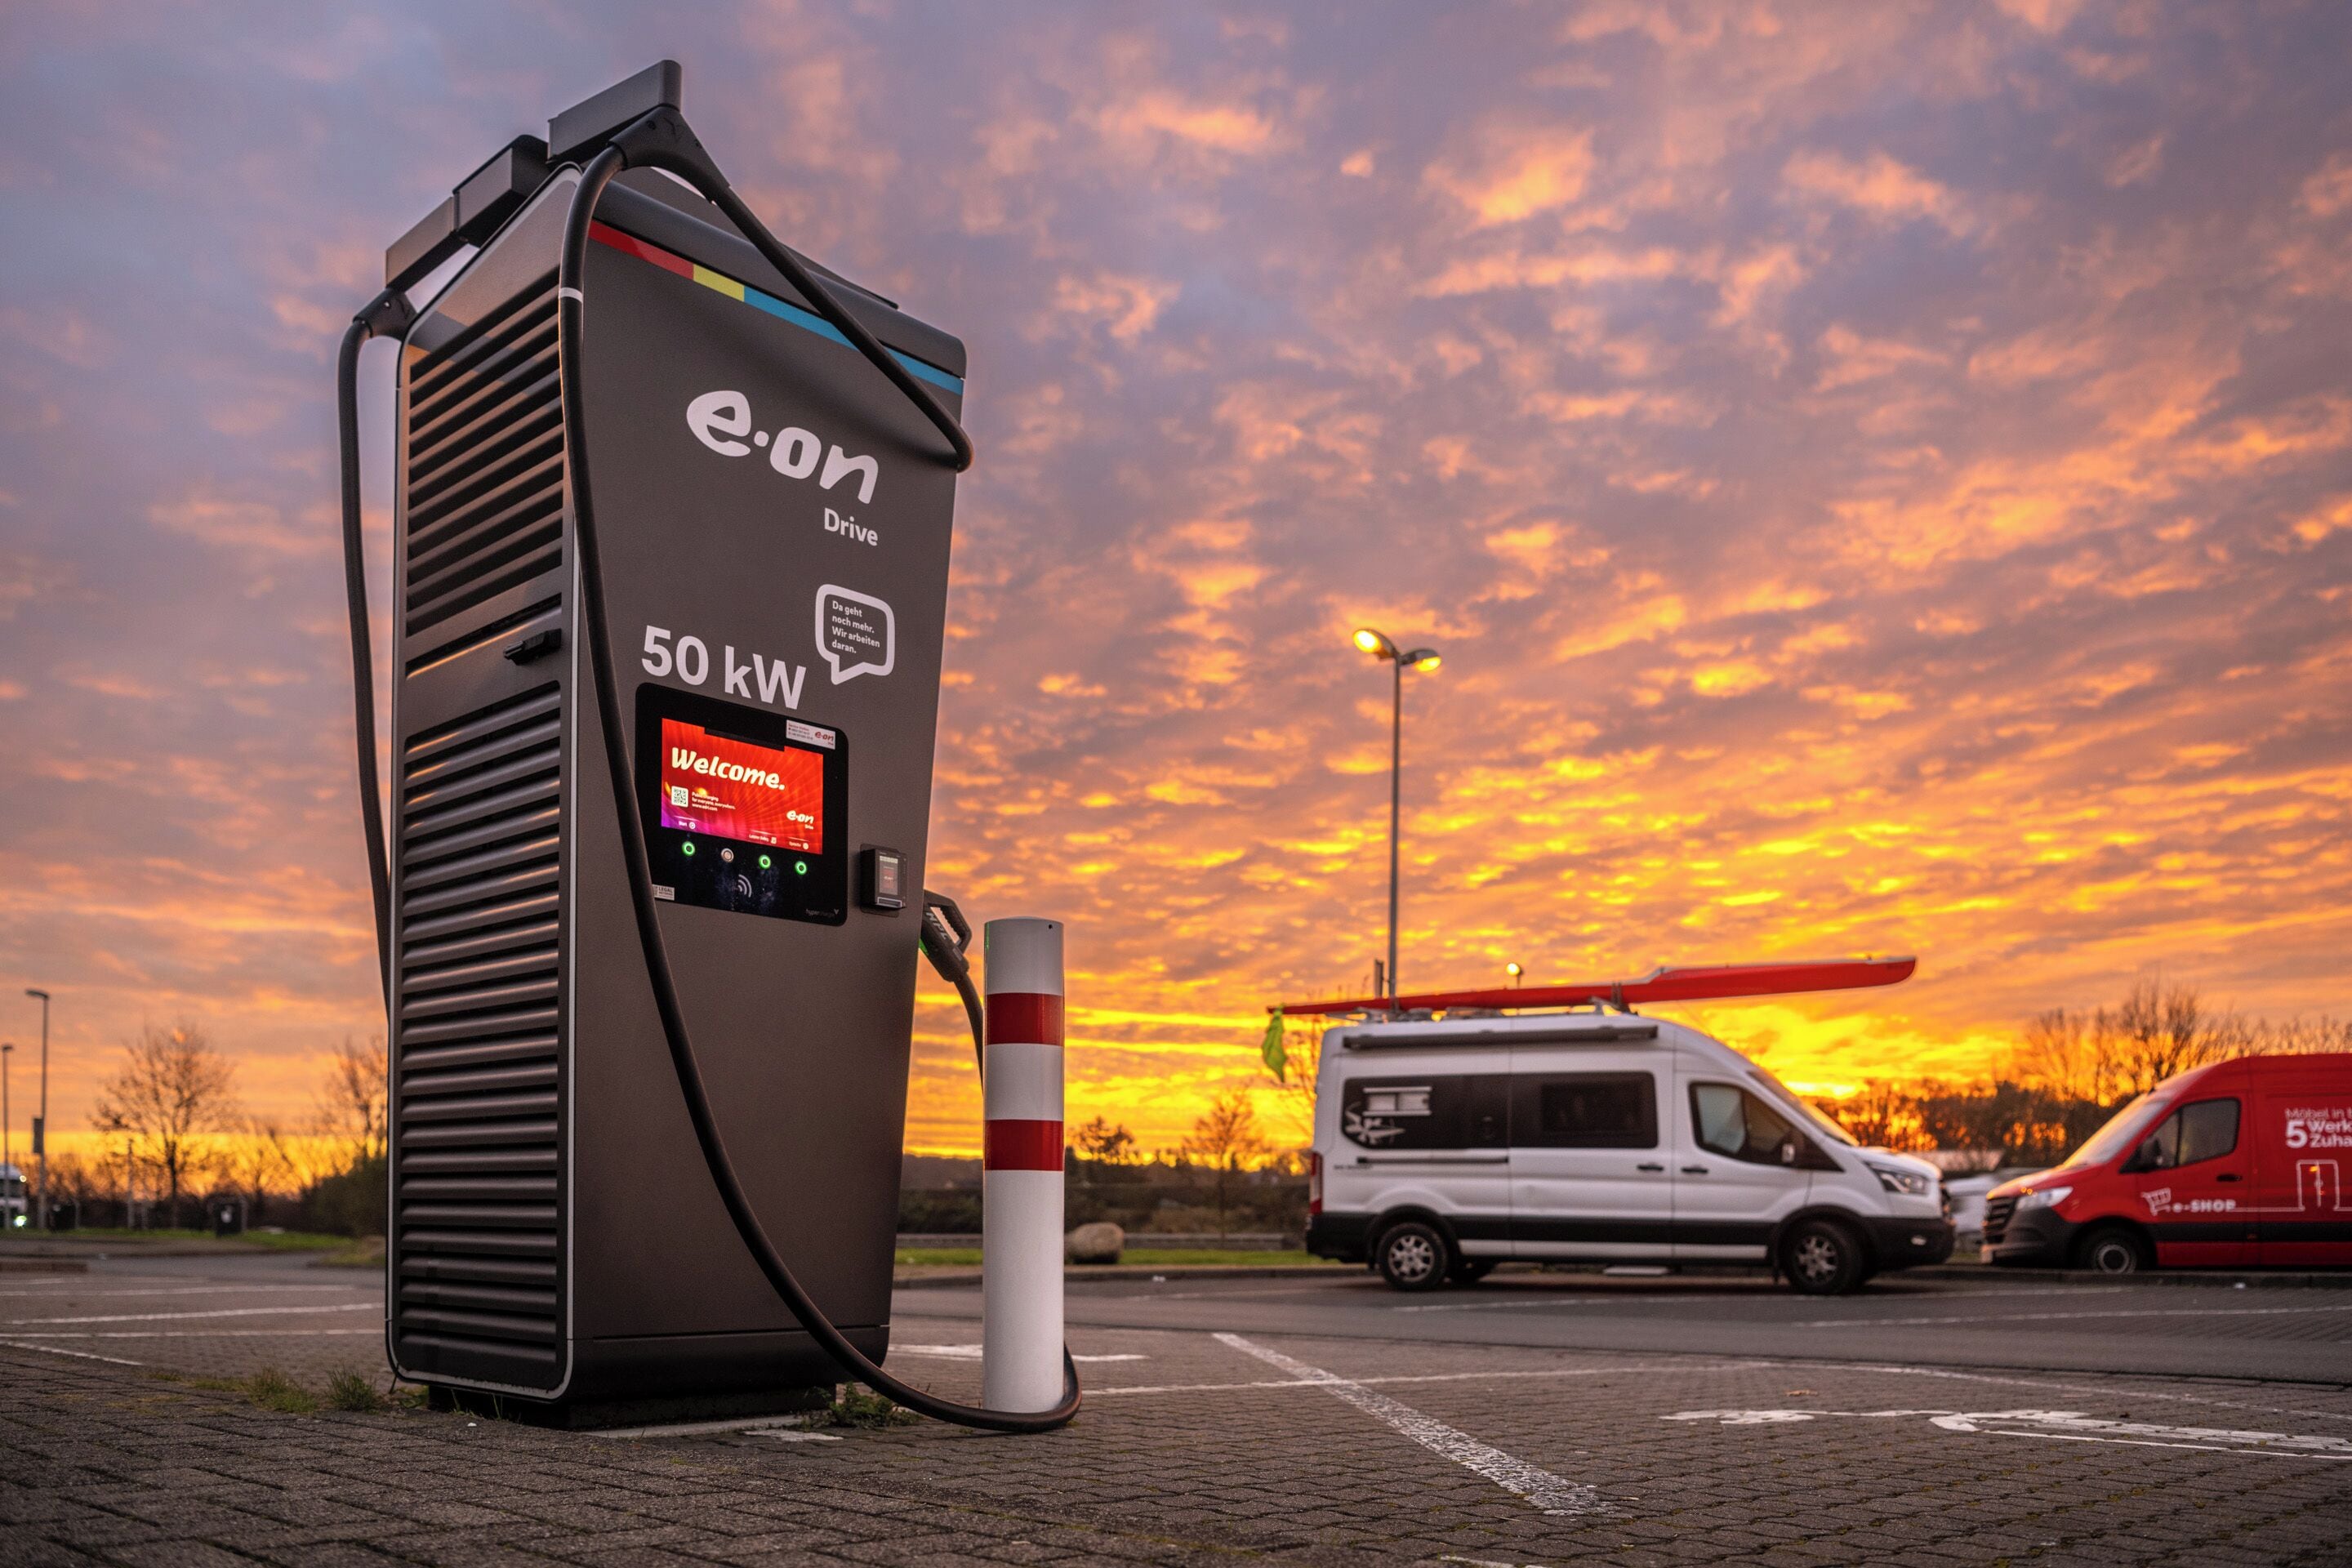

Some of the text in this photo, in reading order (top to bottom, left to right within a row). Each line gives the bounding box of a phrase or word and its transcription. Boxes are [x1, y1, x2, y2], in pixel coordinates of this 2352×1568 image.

[824, 508, 878, 546] Drive
[832, 600, 862, 617] Da geht
[832, 615, 875, 633] noch mehr.
[831, 626, 880, 648] Wir arbeiten
[831, 639, 857, 653] daran.
[642, 625, 806, 710] 50 kW
[671, 747, 785, 790] Welcome.
[2286, 1120, 2308, 1148] 5
[2173, 1199, 2236, 1212] e-SHOP
